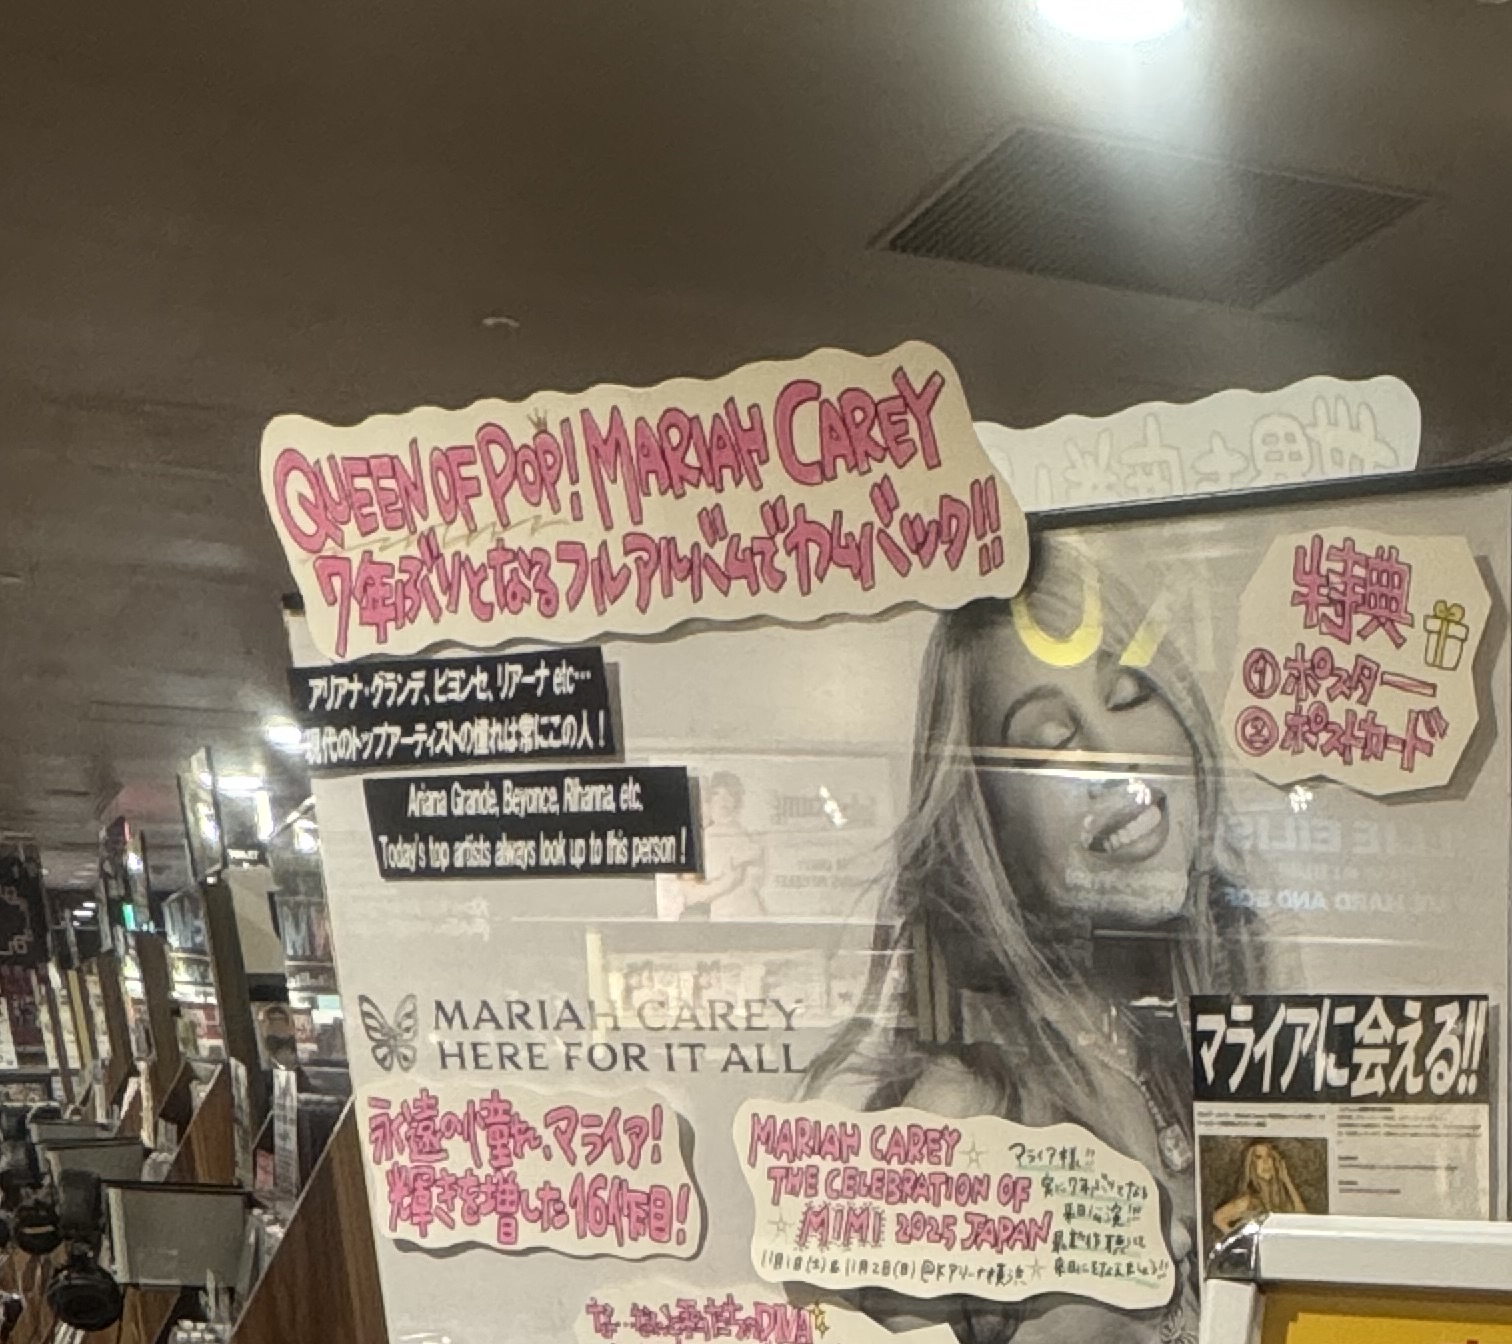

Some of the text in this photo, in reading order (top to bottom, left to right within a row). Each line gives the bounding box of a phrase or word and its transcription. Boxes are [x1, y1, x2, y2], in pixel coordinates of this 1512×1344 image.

[272, 439, 425, 554] QUEEN
[431, 446, 482, 534] OF
[475, 422, 584, 526] POP!
[583, 398, 770, 531] MARIAH
[773, 367, 946, 487] CAREY
[1291, 534, 1415, 649] 特典
[407, 783, 447, 818] Ariana
[450, 780, 499, 818] Grande,
[428, 835, 450, 871] top
[453, 835, 491, 867] artists
[494, 833, 536, 871] always
[540, 831, 566, 866] look
[569, 836, 585, 870] up
[589, 833, 603, 866] to
[606, 828, 628, 866] this
[434, 998, 803, 1033] MARIAH CAREY
[438, 1042, 808, 1075] HERE FOR IT ALL
[748, 1113, 962, 1168] MARIAH CAREY
[767, 1165, 1031, 1213] THE CELEBRATION OF
[798, 1203, 1053, 1254] MIMI 2025 JAPAN
